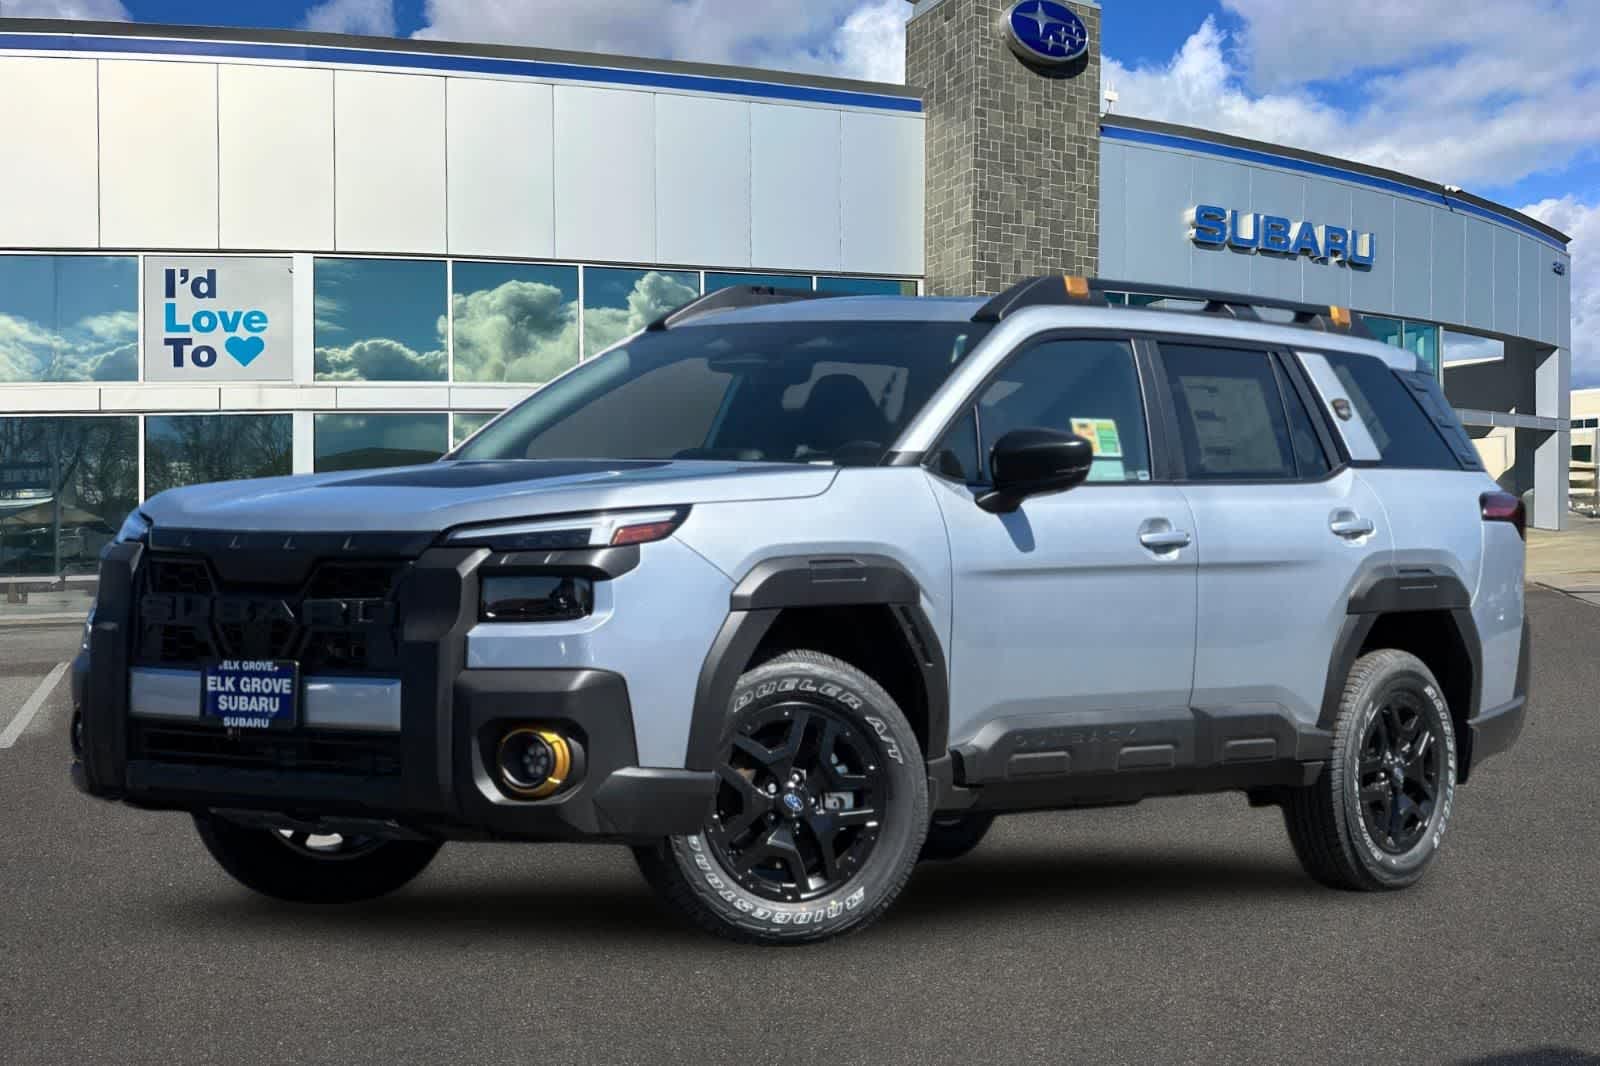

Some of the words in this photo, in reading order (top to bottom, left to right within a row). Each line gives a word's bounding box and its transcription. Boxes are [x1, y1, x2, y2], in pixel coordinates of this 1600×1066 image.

[1193, 204, 1376, 268] SUBARU
[164, 268, 217, 299] I'd
[164, 302, 268, 333] Love
[163, 337, 217, 368] To
[223, 660, 240, 670] ELK
[242, 661, 273, 671] GROVE
[207, 676, 236, 692] ELK
[239, 677, 293, 694] GROVE
[734, 679, 863, 712] DUELER
[218, 695, 280, 713] SUBARU
[223, 716, 270, 728] SUBARU
